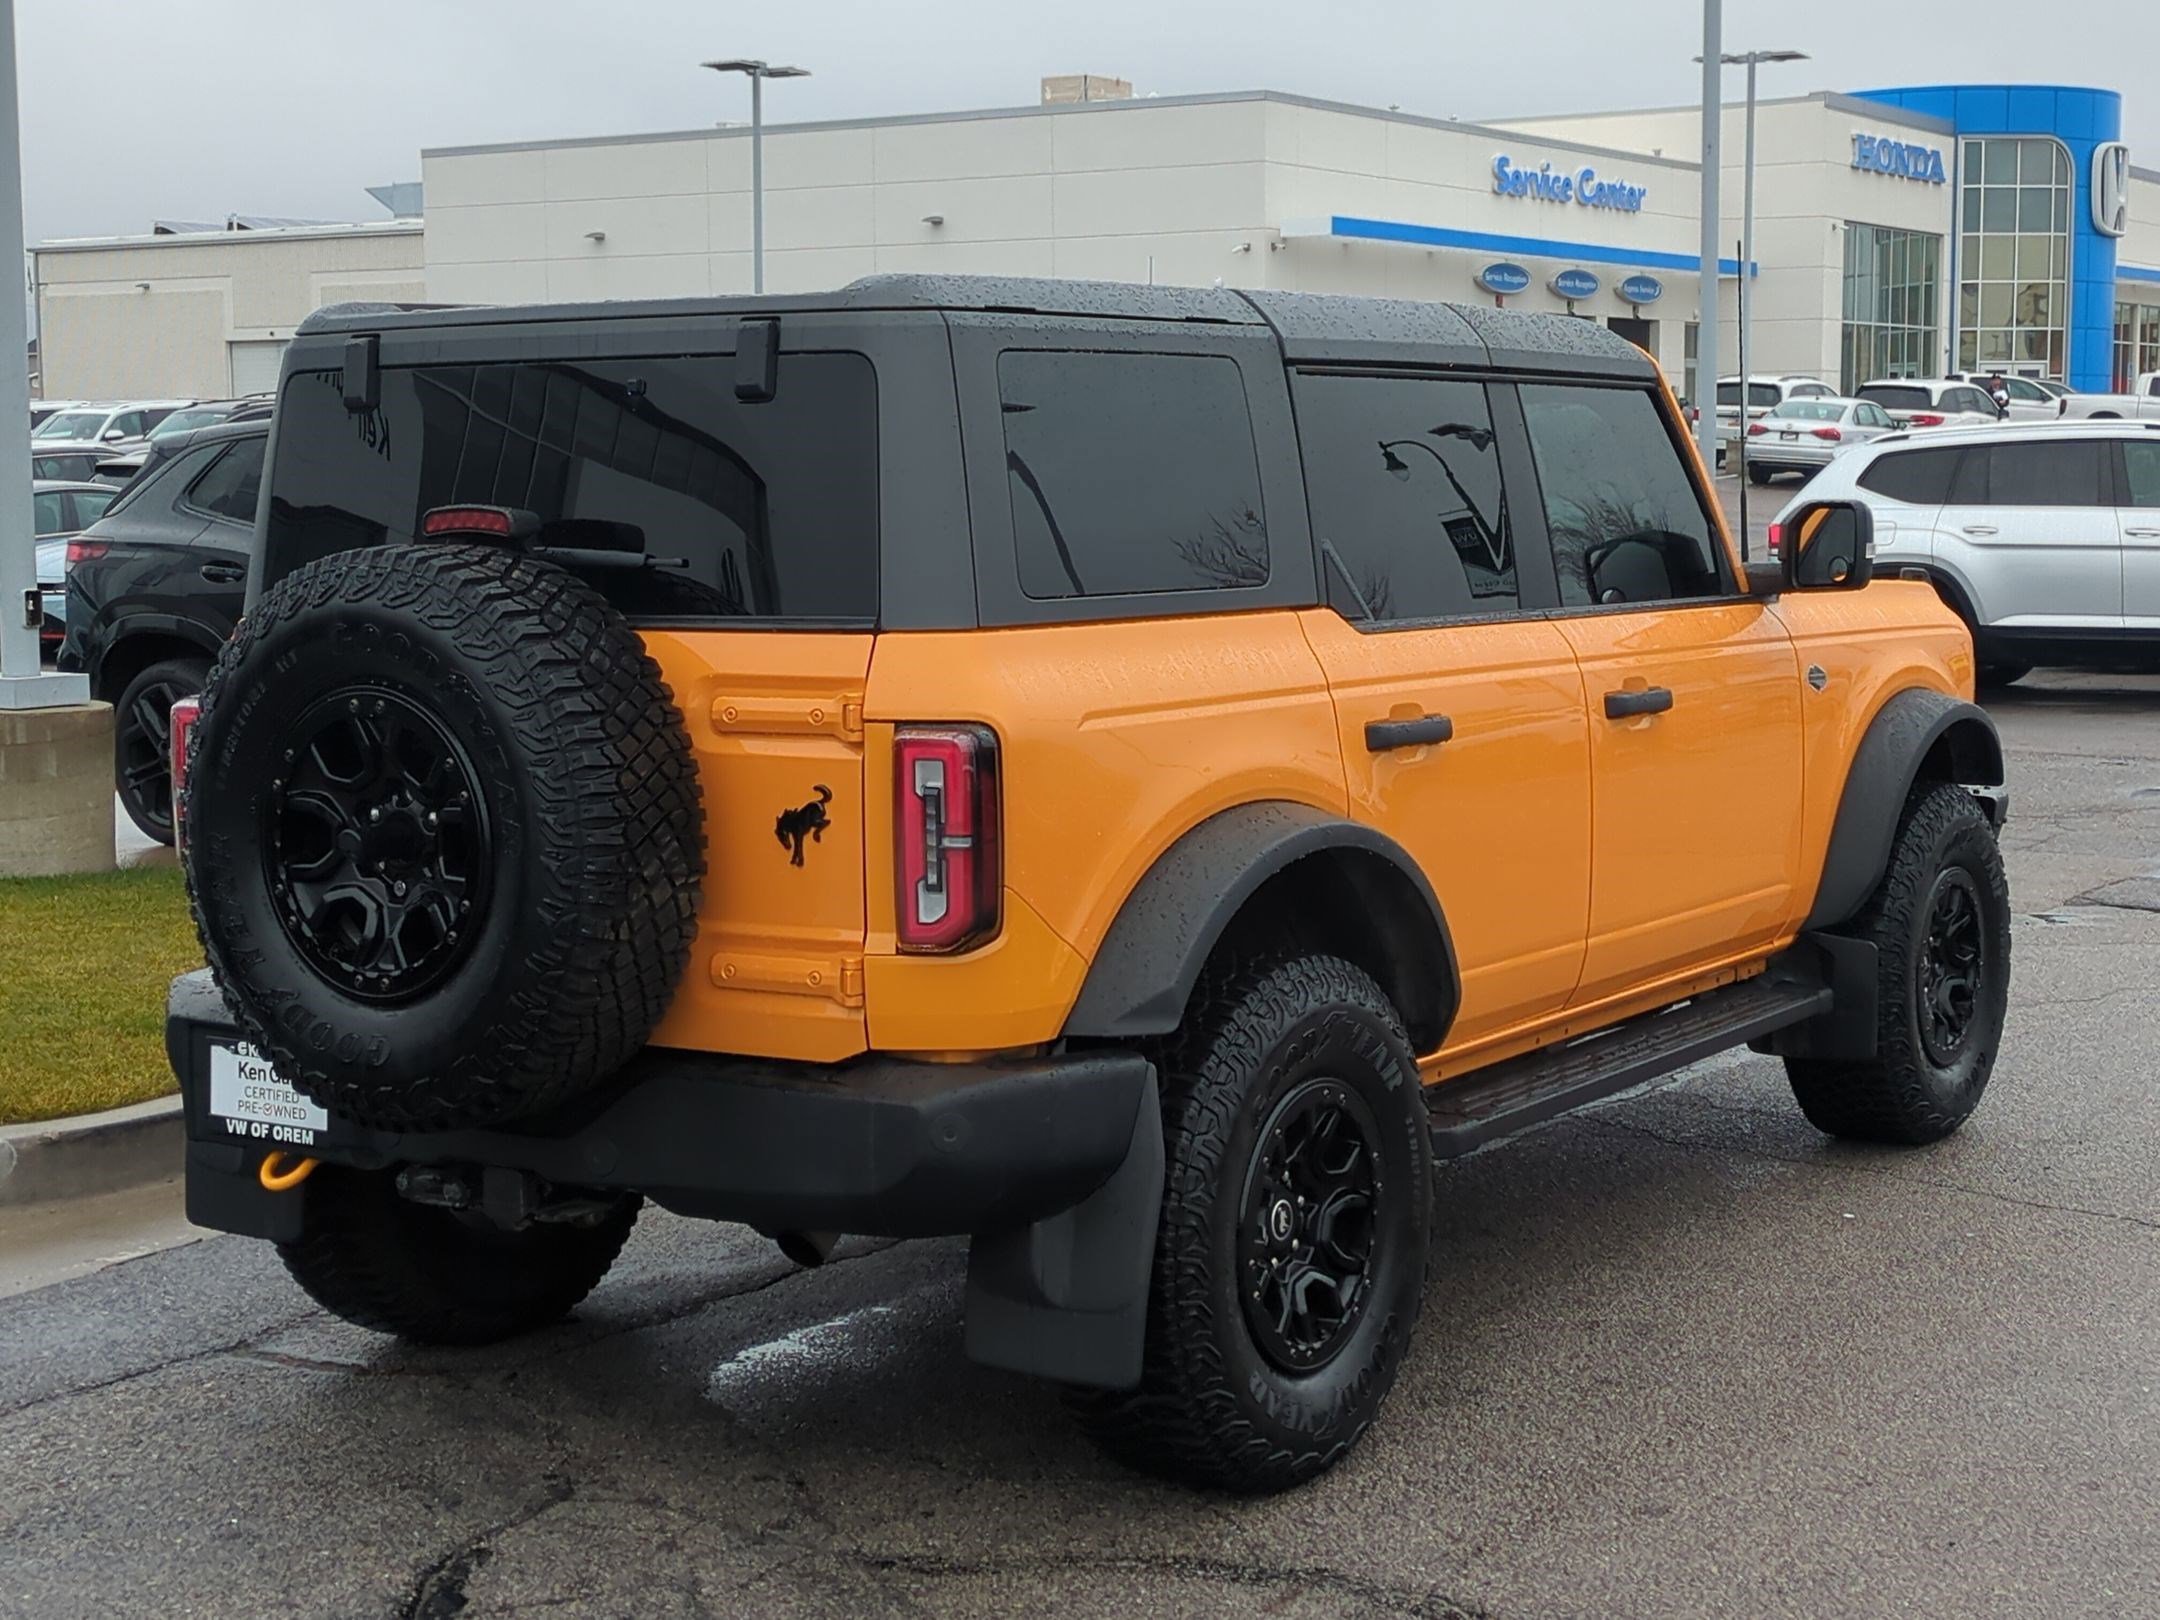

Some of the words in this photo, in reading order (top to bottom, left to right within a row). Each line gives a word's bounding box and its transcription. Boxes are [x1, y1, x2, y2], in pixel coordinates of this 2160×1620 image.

[1850, 132, 1946, 184] HONDA
[1493, 154, 1574, 203] Service
[1575, 165, 1647, 213] Center
[238, 1060, 267, 1082] Ken
[244, 1085, 300, 1104] CERTIFIED
[226, 1118, 248, 1136] VW
[251, 1122, 270, 1139] OF
[273, 1125, 314, 1147] OREM
